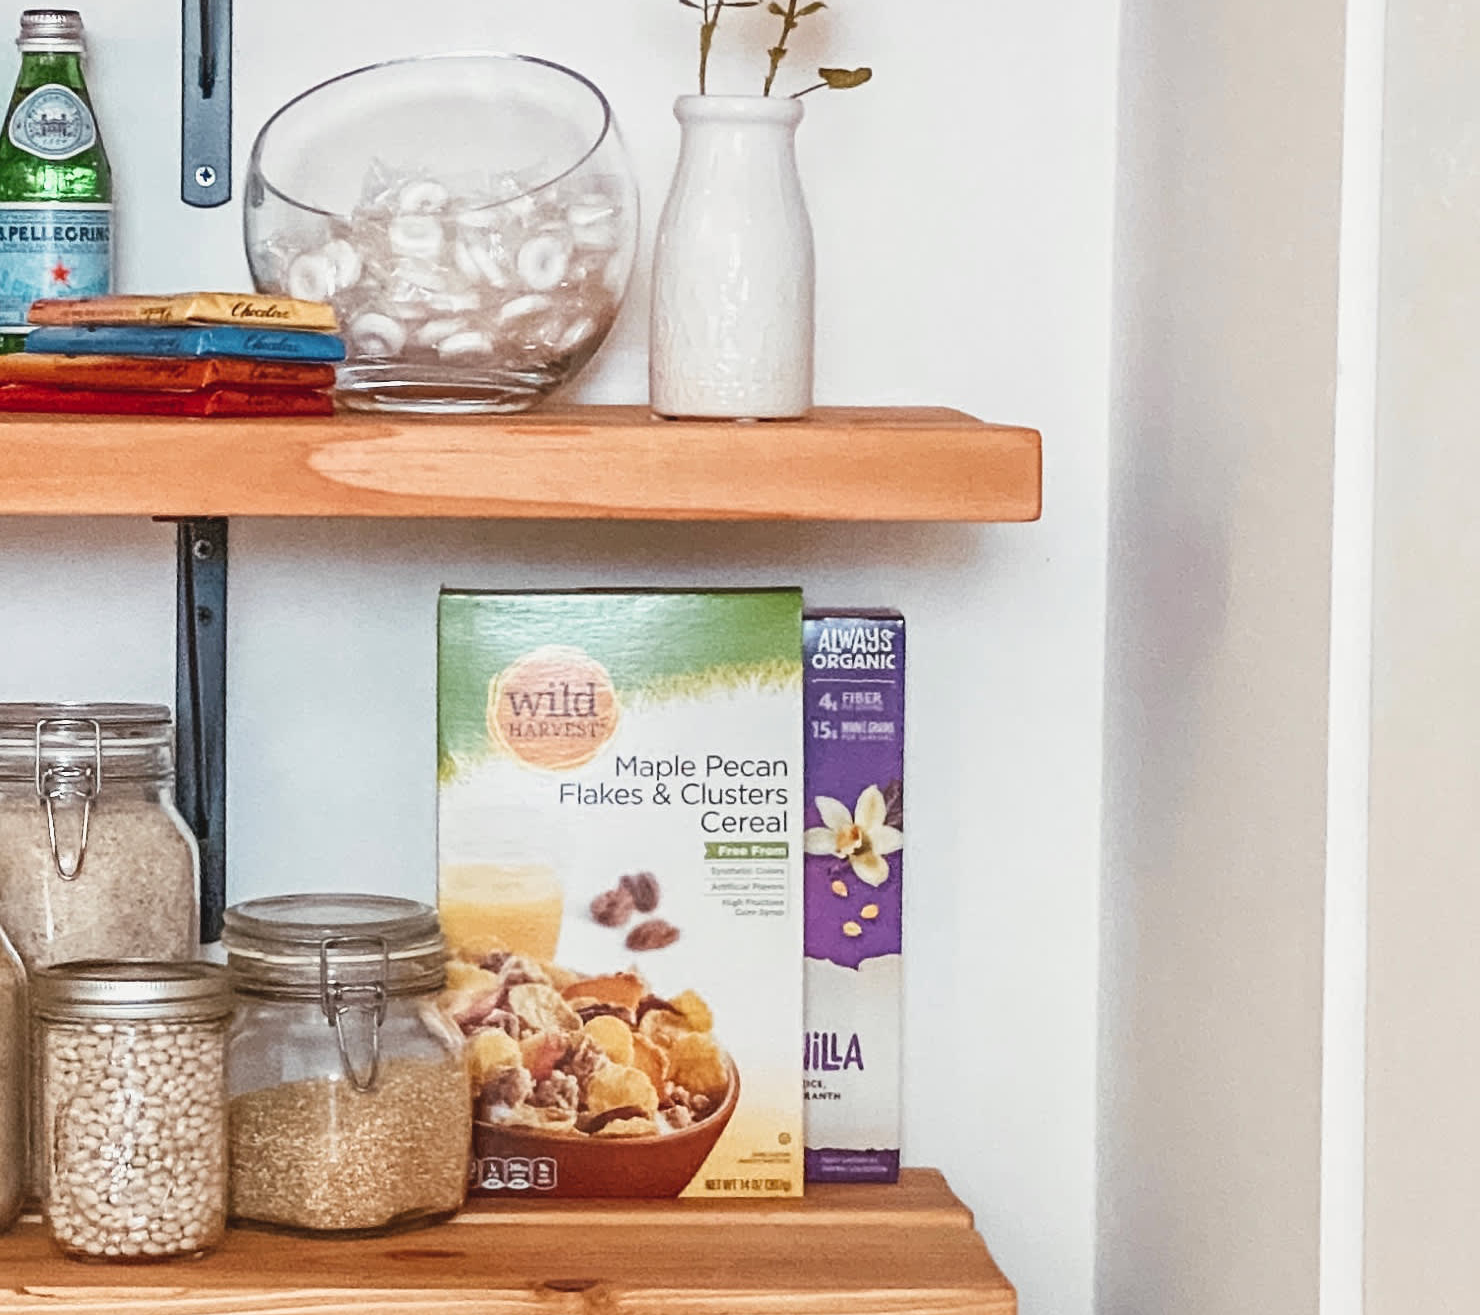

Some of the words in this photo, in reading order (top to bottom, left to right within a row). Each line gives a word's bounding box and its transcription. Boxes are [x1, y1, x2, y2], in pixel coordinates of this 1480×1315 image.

[818, 627, 895, 654] ALWAYS
[811, 653, 896, 670] ORGANIC
[504, 681, 599, 717] wild
[841, 691, 882, 705] FIBER
[509, 722, 596, 738] HARVEST
[616, 755, 697, 781] Maple
[705, 755, 789, 778] Pecan
[559, 782, 644, 806] Flakes
[652, 782, 672, 806] &
[681, 782, 789, 806] Clusters
[700, 810, 788, 834] Cereal
[718, 845, 748, 857] Free
[751, 845, 787, 857] From
